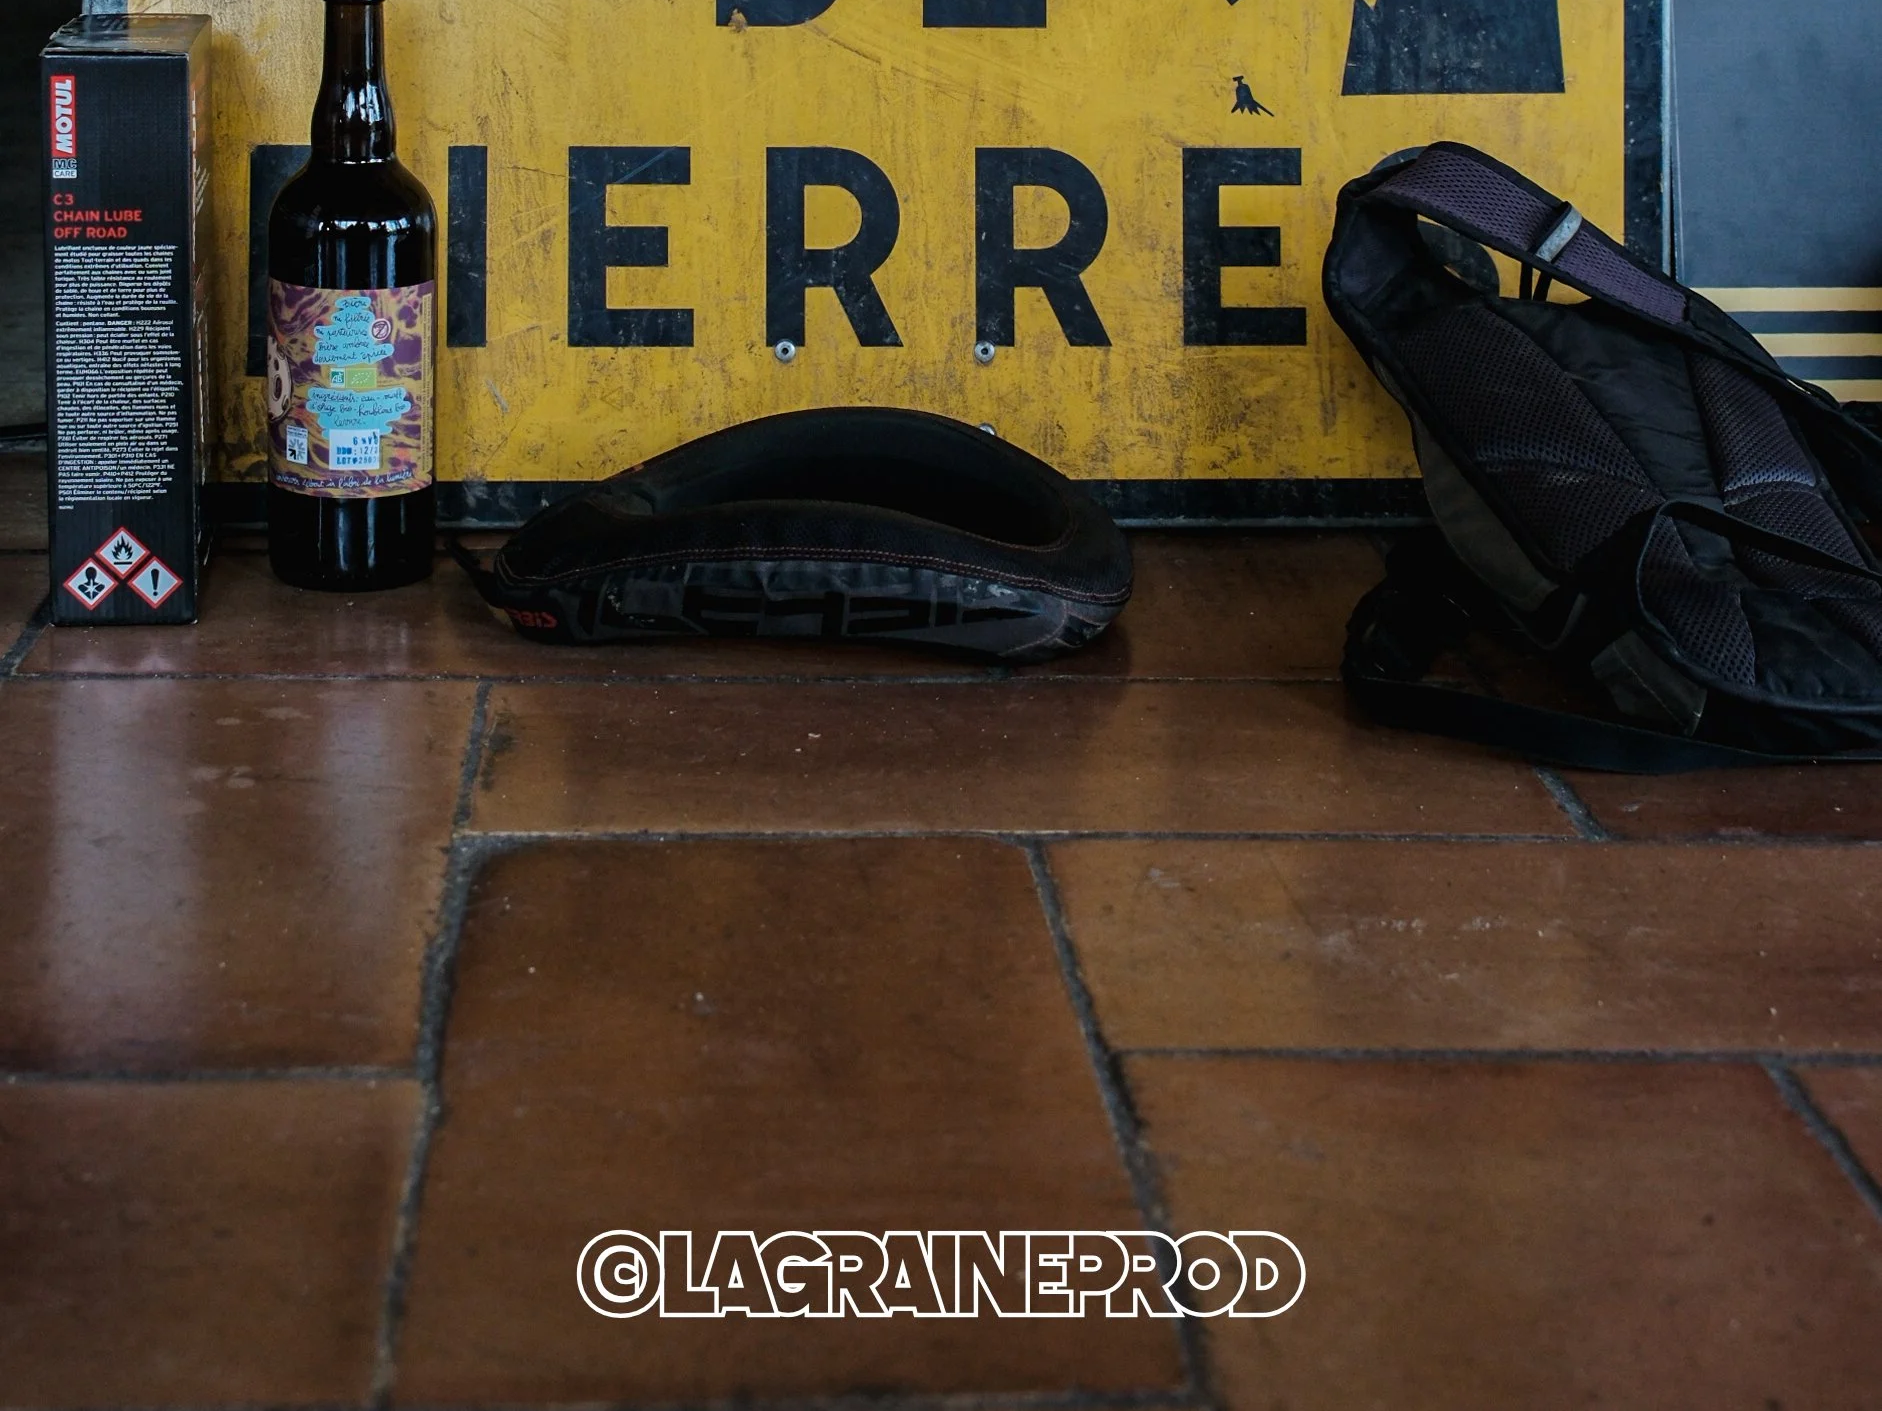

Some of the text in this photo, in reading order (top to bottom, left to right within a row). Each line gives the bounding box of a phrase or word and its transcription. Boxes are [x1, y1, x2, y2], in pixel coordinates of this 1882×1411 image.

[54, 78, 74, 154] MOTUL
[52, 158, 77, 169] MC
[54, 170, 77, 178] CARE
[53, 210, 142, 222] CHAIN LUBE
[54, 227, 127, 239] OFF ROAD
[249, 144, 1500, 376] IERRE
